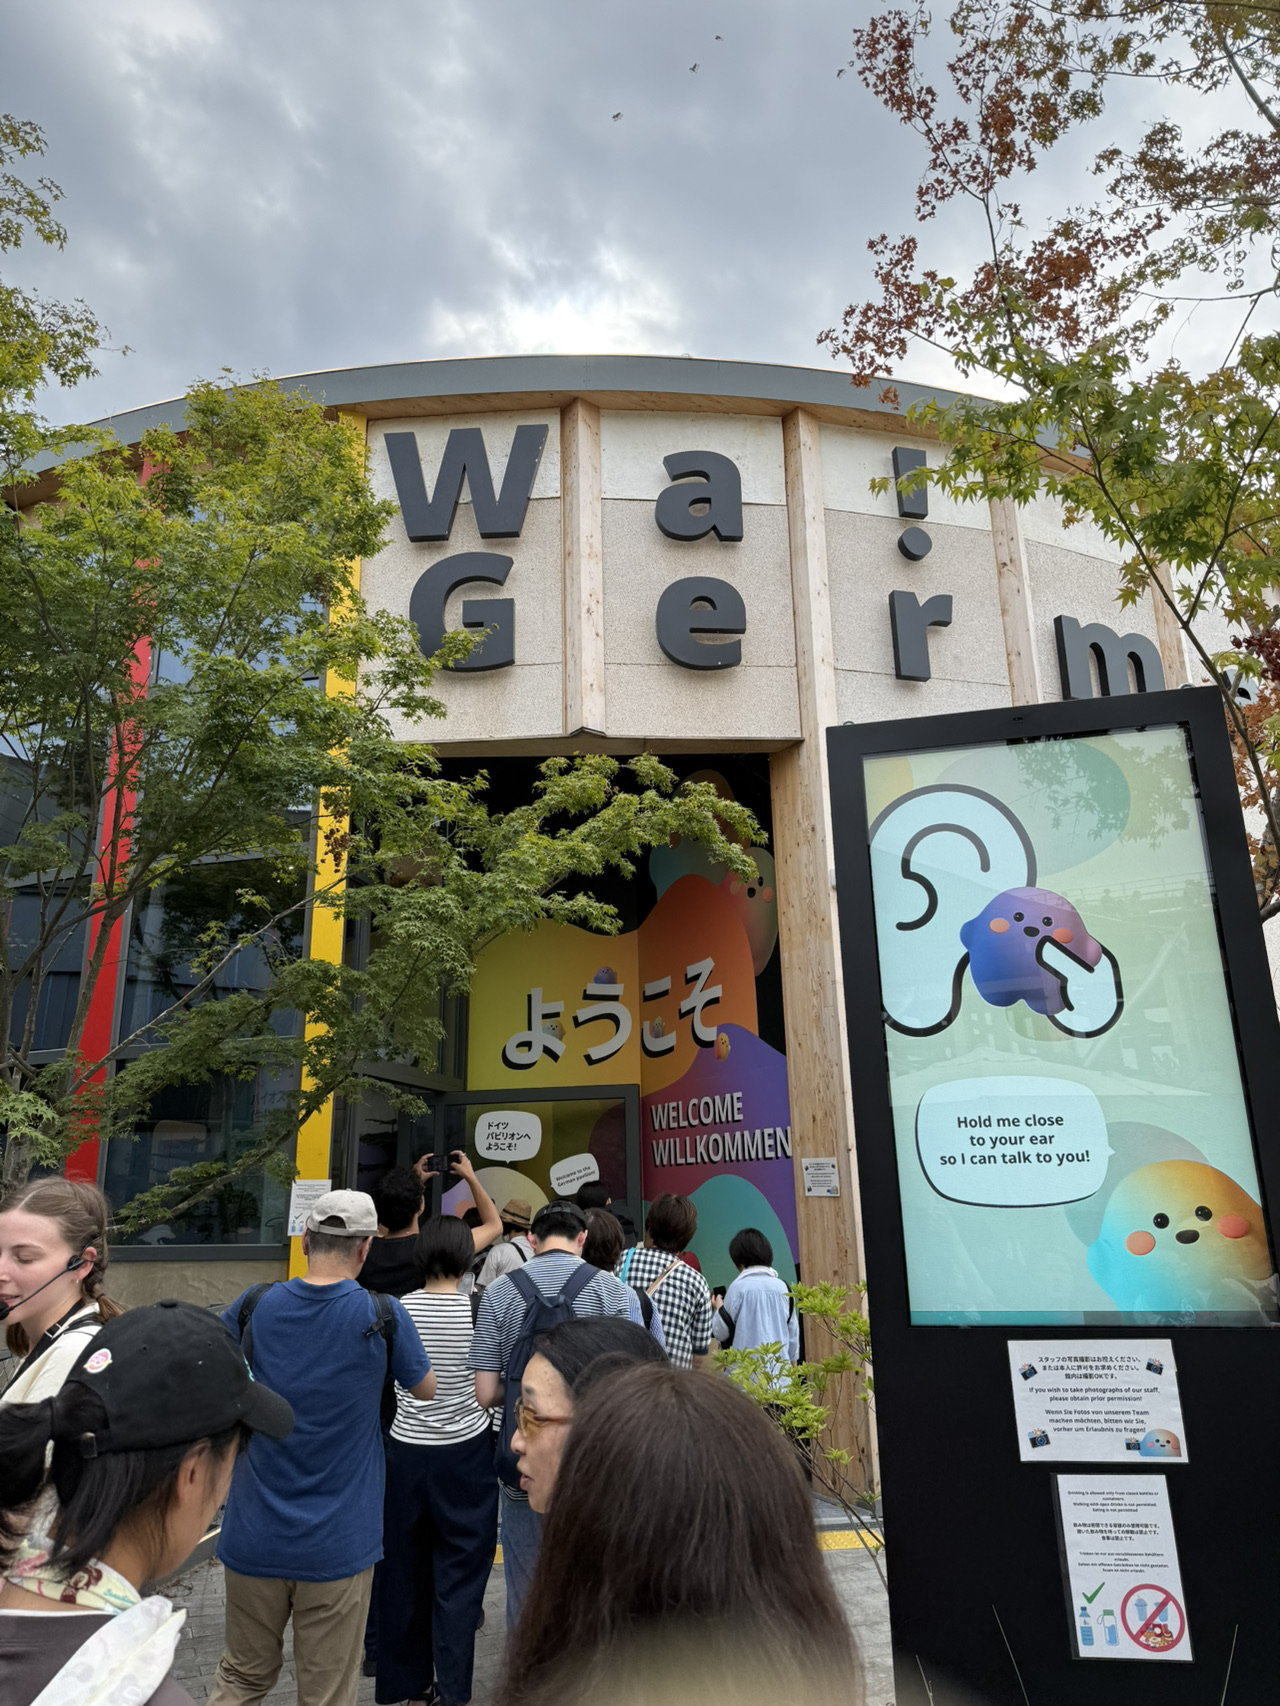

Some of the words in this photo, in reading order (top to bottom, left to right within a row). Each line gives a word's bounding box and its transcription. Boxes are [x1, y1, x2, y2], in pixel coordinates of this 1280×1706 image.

[502, 956, 723, 1068] ようこそ
[652, 1092, 743, 1130] WELCOME
[488, 1122, 508, 1130] ドイツ
[957, 1116, 992, 1128] Hold
[997, 1117, 1020, 1127] me
[1025, 1114, 1064, 1126] close
[486, 1143, 517, 1151] ようこそ!
[652, 1126, 793, 1166] WILLKOMMEN
[970, 1136, 985, 1146] to
[990, 1135, 1025, 1149] your
[1030, 1134, 1055, 1144] ear
[940, 1155, 956, 1165] so
[961, 1153, 965, 1165] I
[970, 1153, 997, 1164] can
[1002, 1151, 1032, 1164] talk
[1036, 1152, 1051, 1163] to
[1056, 1150, 1090, 1166] you!
[556, 1171, 576, 1182] Welcome
